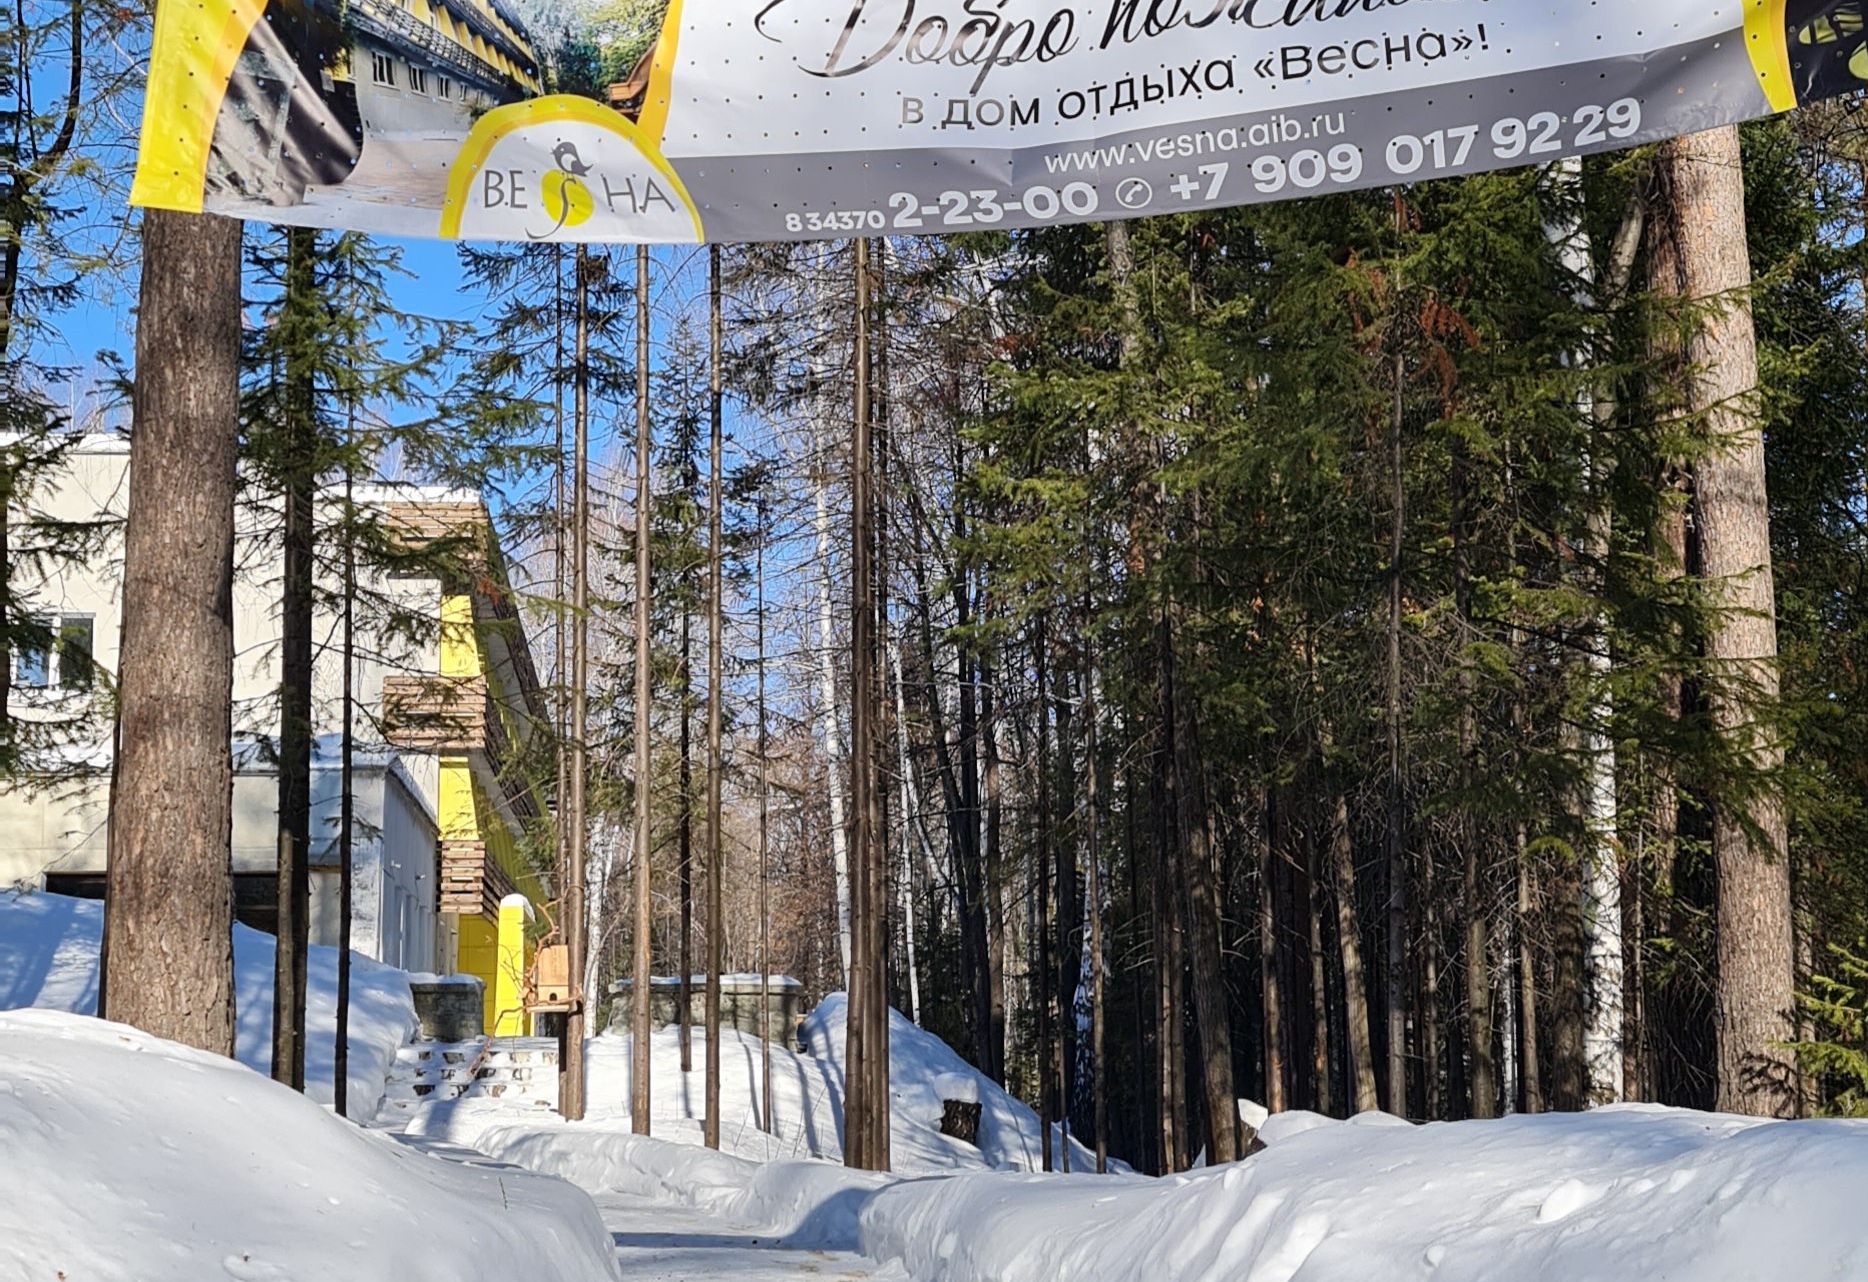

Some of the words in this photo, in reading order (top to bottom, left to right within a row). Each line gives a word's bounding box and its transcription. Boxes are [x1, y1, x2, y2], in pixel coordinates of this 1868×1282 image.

[941, 98, 1040, 130] дом
[1057, 58, 1234, 120] отдыха
[1253, 23, 1490, 81] «Весна»!
[888, 181, 1098, 228] 2-23-00
[1170, 162, 1229, 201] +7
[1249, 142, 1363, 194] 909
[1385, 124, 1479, 174] 017
[1044, 110, 1345, 174] www.vesna.aib.ru
